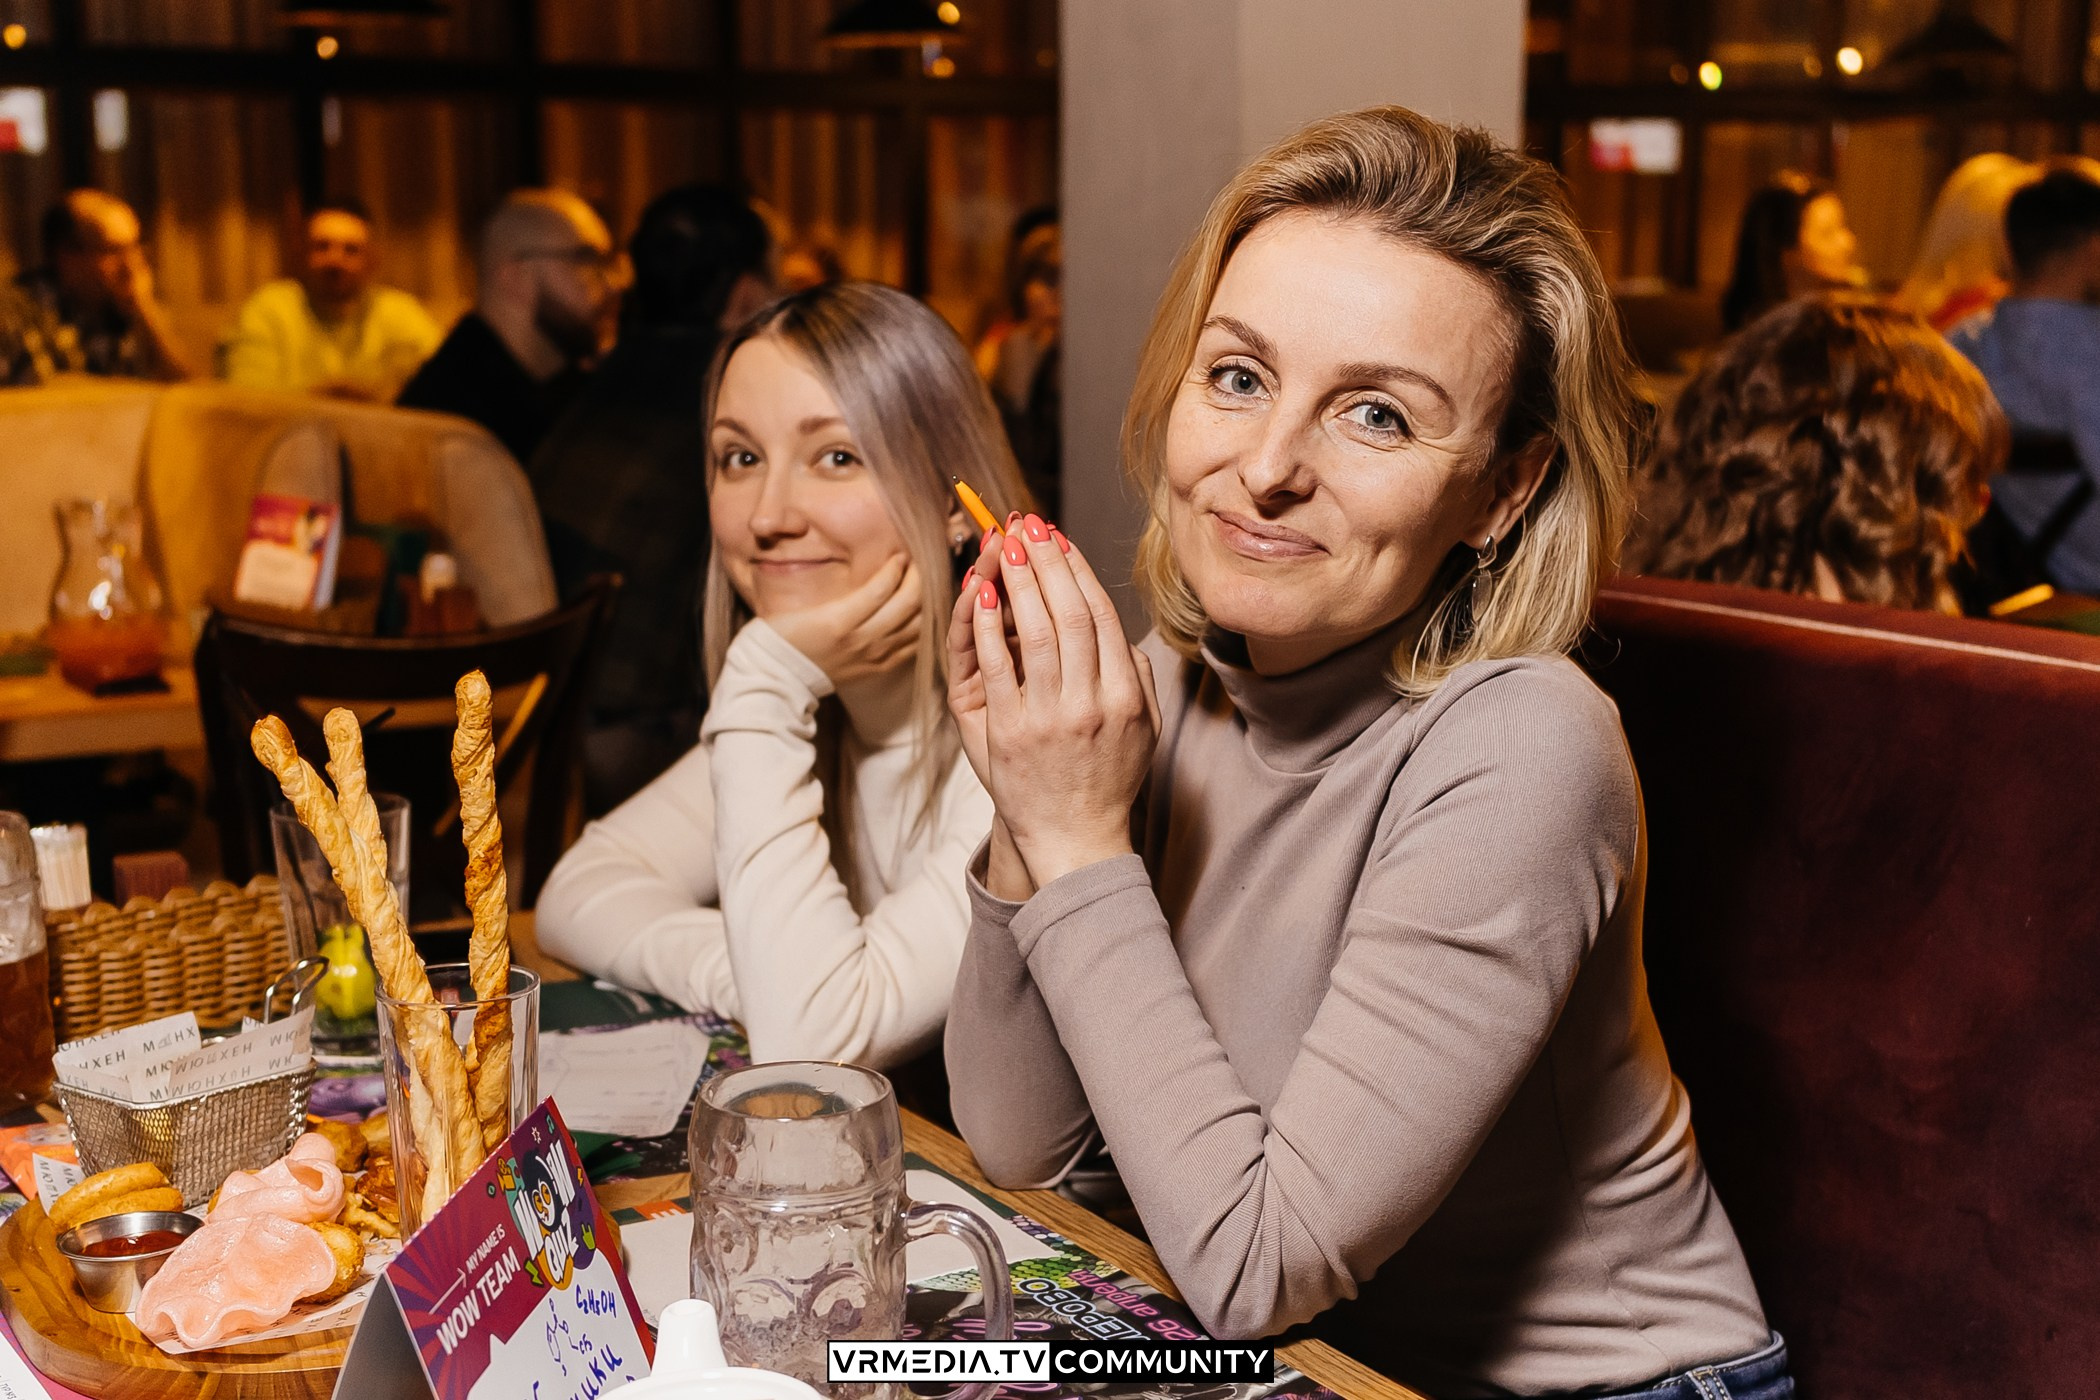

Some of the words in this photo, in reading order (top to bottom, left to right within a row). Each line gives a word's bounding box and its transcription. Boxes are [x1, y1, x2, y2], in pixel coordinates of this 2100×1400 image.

[465, 1251, 480, 1274] MY
[476, 1230, 500, 1262] NAME
[495, 1223, 506, 1240] IS
[436, 1289, 481, 1356] WOW
[476, 1245, 521, 1307] TEAM
[1065, 1268, 1160, 1318] апреля
